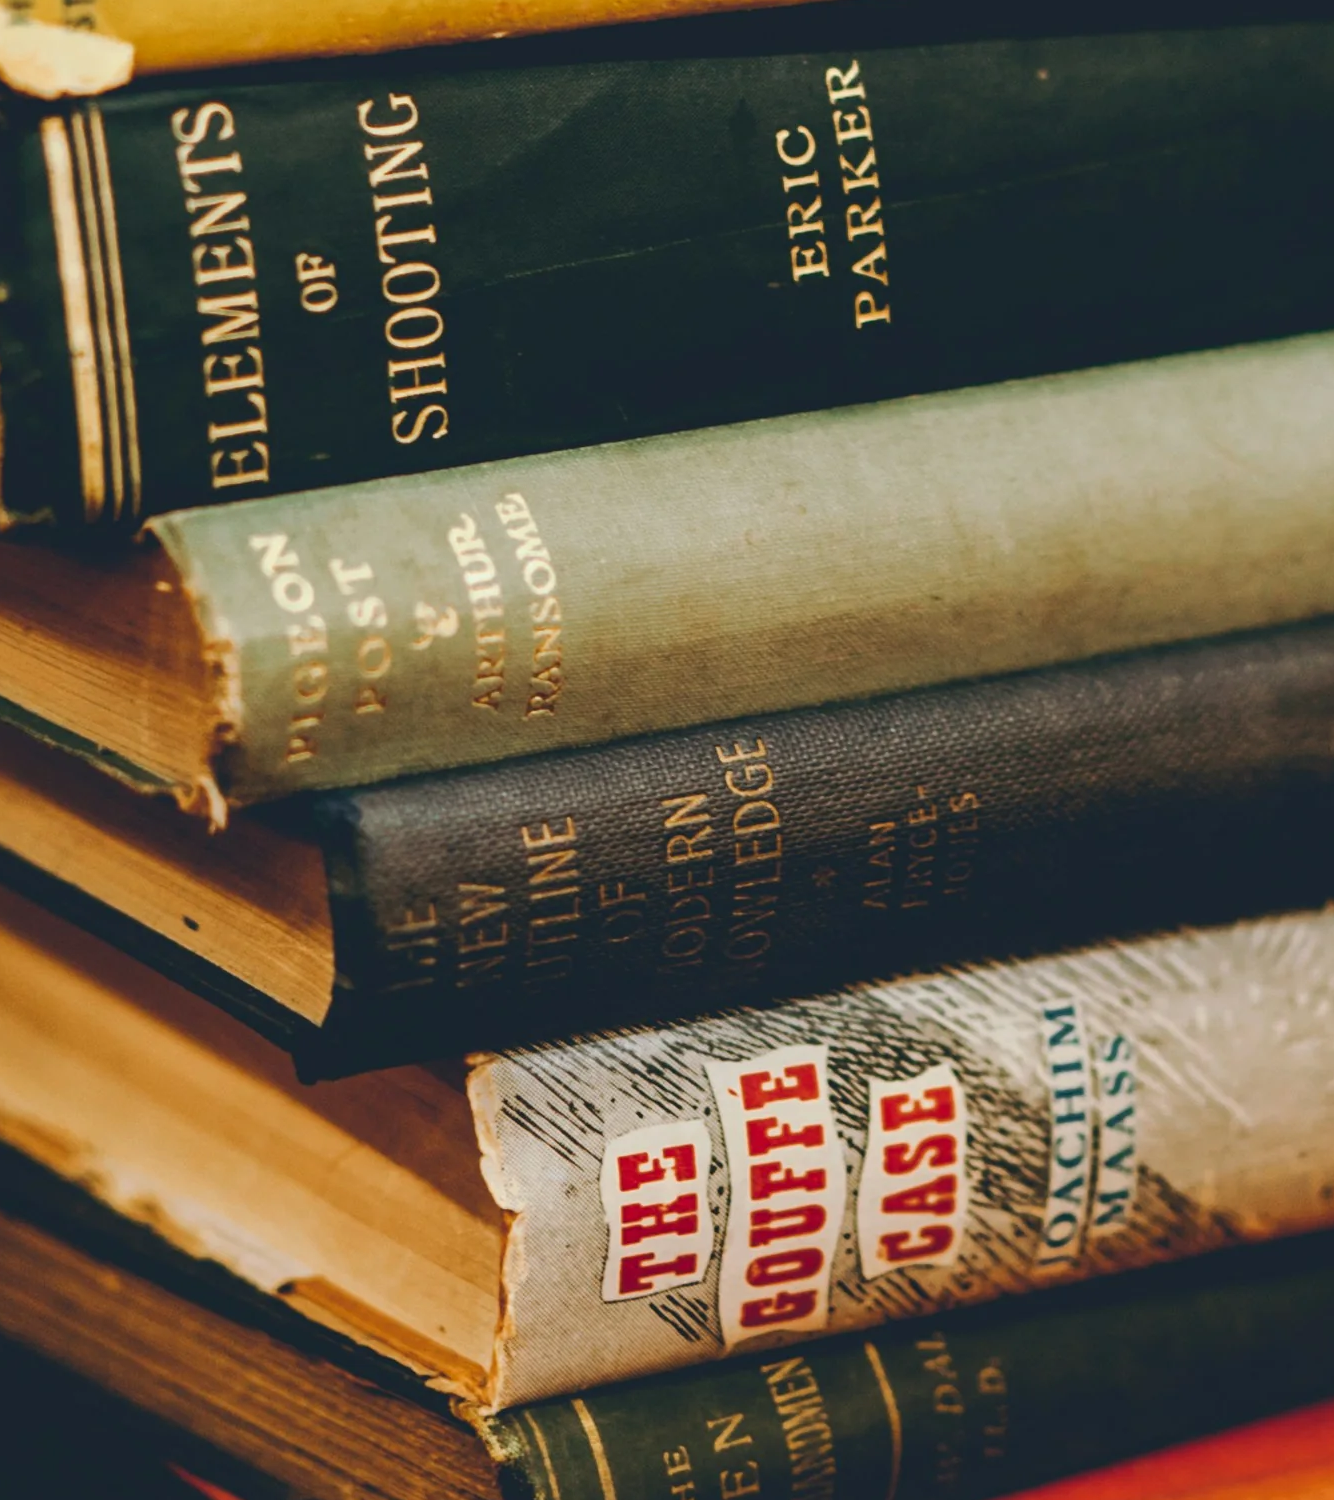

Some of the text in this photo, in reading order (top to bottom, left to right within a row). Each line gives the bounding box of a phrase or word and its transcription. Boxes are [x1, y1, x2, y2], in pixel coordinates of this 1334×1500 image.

[295, 252, 339, 312] OF
[357, 90, 449, 446] SHOOTING
[776, 124, 830, 285] ERIC
[824, 59, 892, 329] PARKER
[173, 100, 269, 489] ELEMENTS
[250, 533, 330, 763] PIGEON
[330, 556, 394, 714] POST
[447, 513, 505, 713] ARTHUR
[495, 492, 564, 720] RANSOME
[522, 815, 577, 987] UTLINE
[617, 1142, 698, 1295] THE
[728, 1062, 828, 1330] GOUFFÉ
[878, 1085, 956, 1263] CASE
[1096, 1034, 1137, 1227] MAASS
